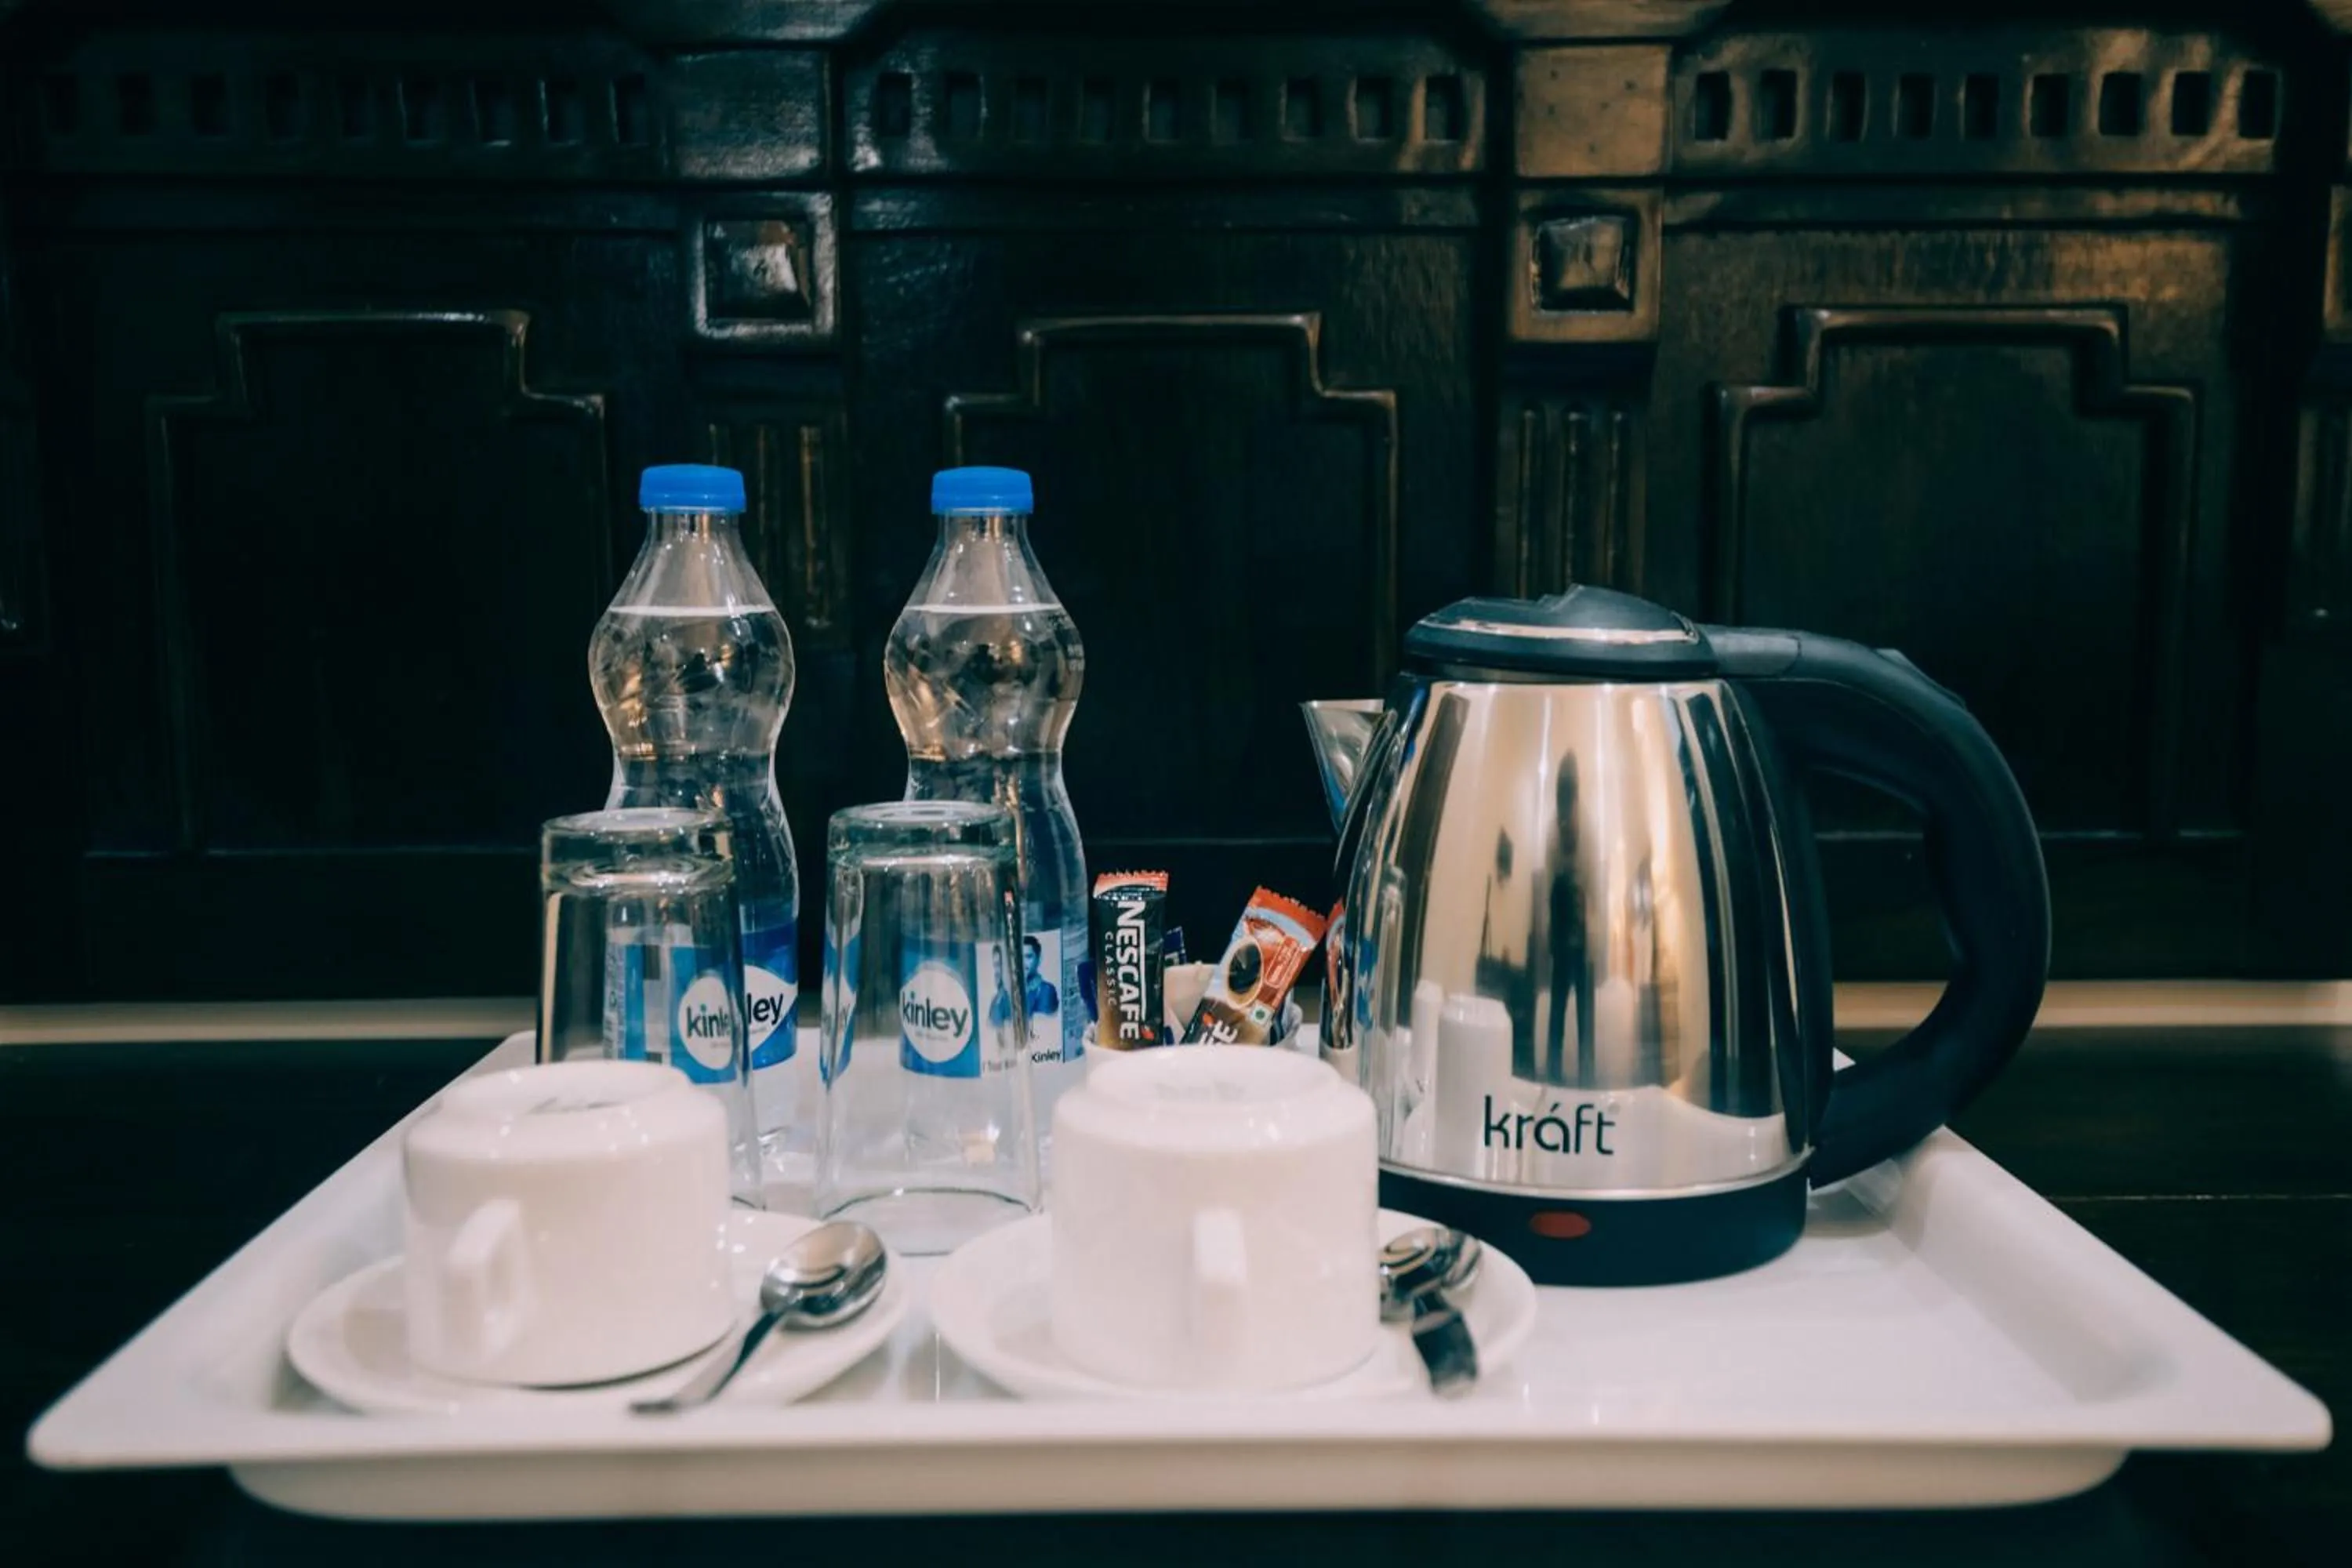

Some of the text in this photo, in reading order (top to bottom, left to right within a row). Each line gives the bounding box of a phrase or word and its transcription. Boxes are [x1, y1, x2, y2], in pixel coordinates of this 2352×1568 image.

[1105, 931, 1117, 1005] CLASSIC
[902, 990, 967, 1038] kinley
[1484, 1094, 1615, 1156] kráft
